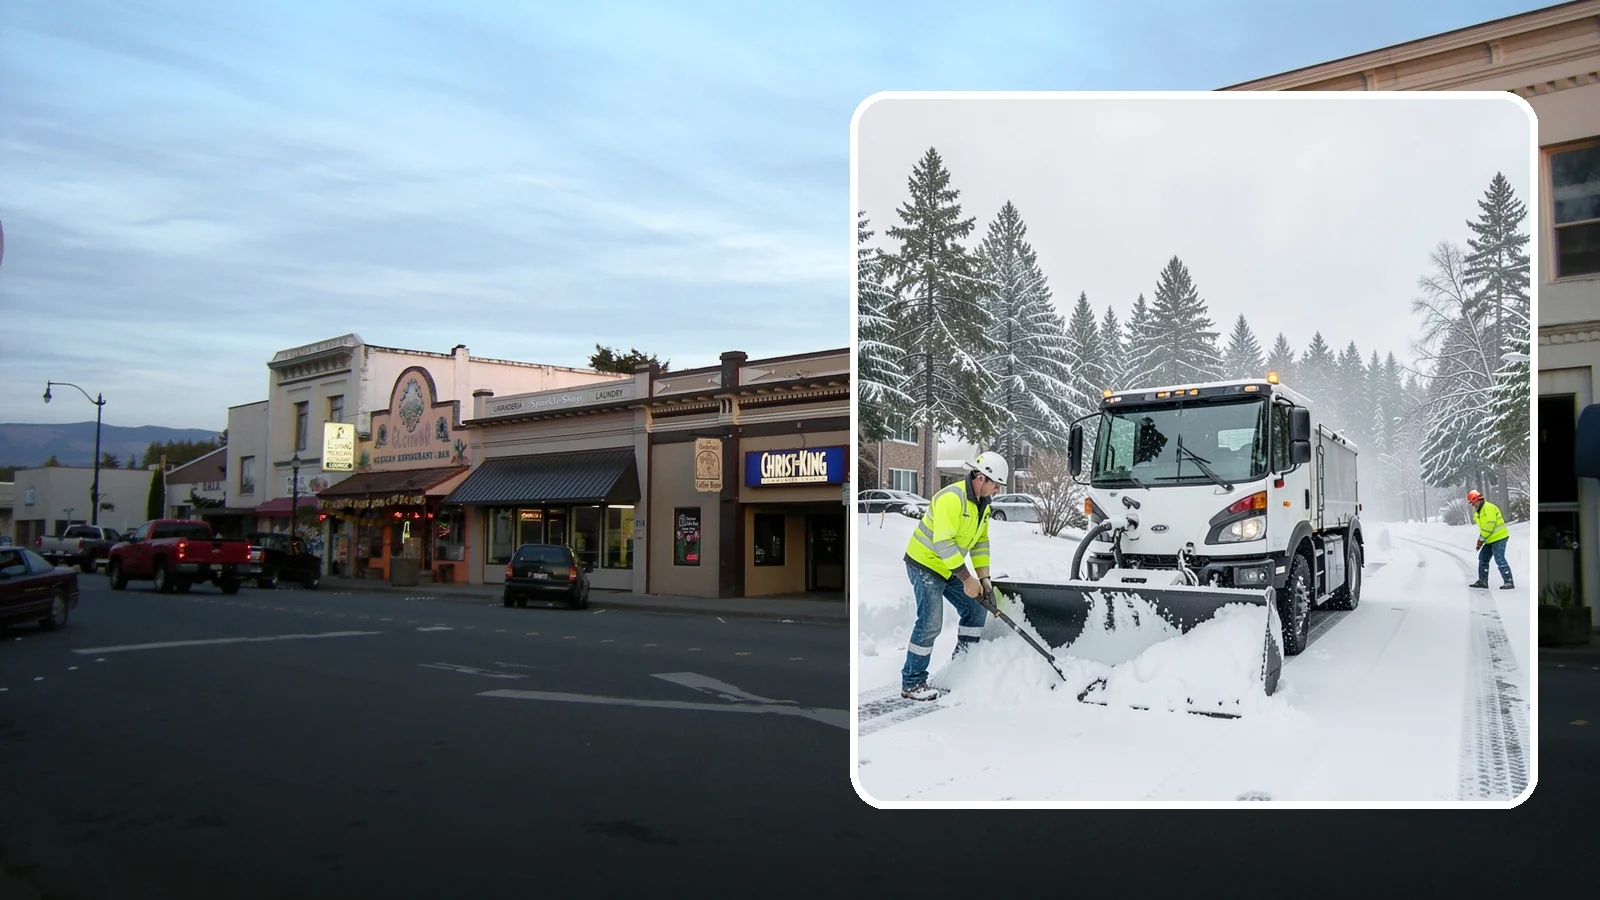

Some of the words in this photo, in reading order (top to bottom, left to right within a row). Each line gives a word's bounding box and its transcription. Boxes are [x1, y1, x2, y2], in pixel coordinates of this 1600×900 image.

[595, 389, 623, 400] LAUNDRY
[531, 397, 561, 409] Sparkle
[562, 394, 583, 404] Shop
[493, 402, 523, 413] LAVANDERIA
[374, 455, 396, 464] MEXICAN
[397, 452, 433, 462] RESTAURANT
[438, 450, 450, 459] BAR
[696, 480, 709, 489] Coffee
